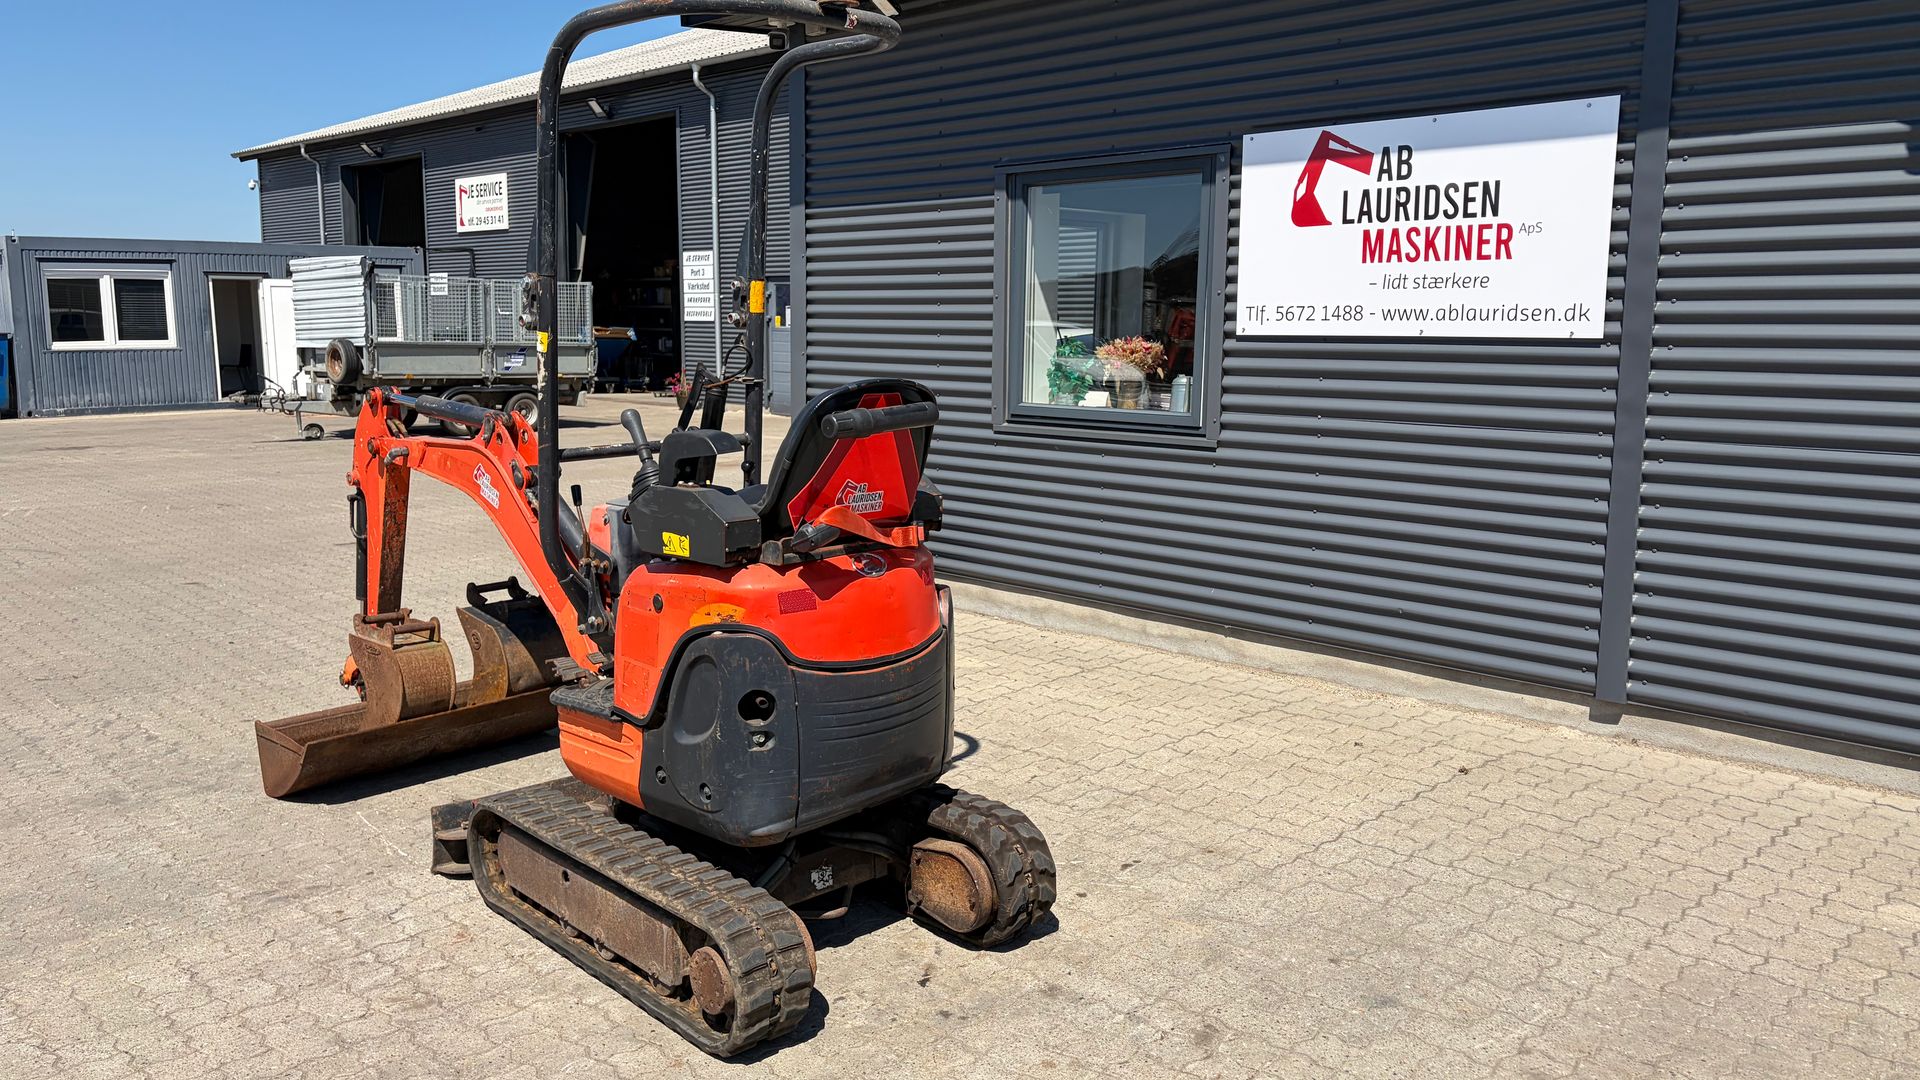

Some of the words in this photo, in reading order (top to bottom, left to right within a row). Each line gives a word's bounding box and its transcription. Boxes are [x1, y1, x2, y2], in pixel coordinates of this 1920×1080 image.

[1376, 145, 1413, 182] AB
[468, 185, 474, 199] JE
[476, 182, 502, 198] SERVICE
[1342, 180, 1501, 224] LAURIDSEN
[476, 217, 482, 225] 29
[483, 216, 489, 225] 45
[491, 216, 496, 224] 31
[498, 215, 504, 224] 41
[1361, 222, 1513, 264] MASKINER
[1519, 221, 1543, 235] ApS
[1382, 274, 1408, 290] lidt
[1412, 273, 1490, 289] stærkere
[1246, 305, 1270, 325] Tlf.
[1275, 305, 1316, 322] 5672
[1321, 305, 1364, 321] 1488
[1381, 303, 1591, 323] www.ablauridsen.dk
[858, 484, 867, 493] AB
[848, 493, 882, 504] LAURIDSEN
[852, 502, 882, 512] MASKINER
